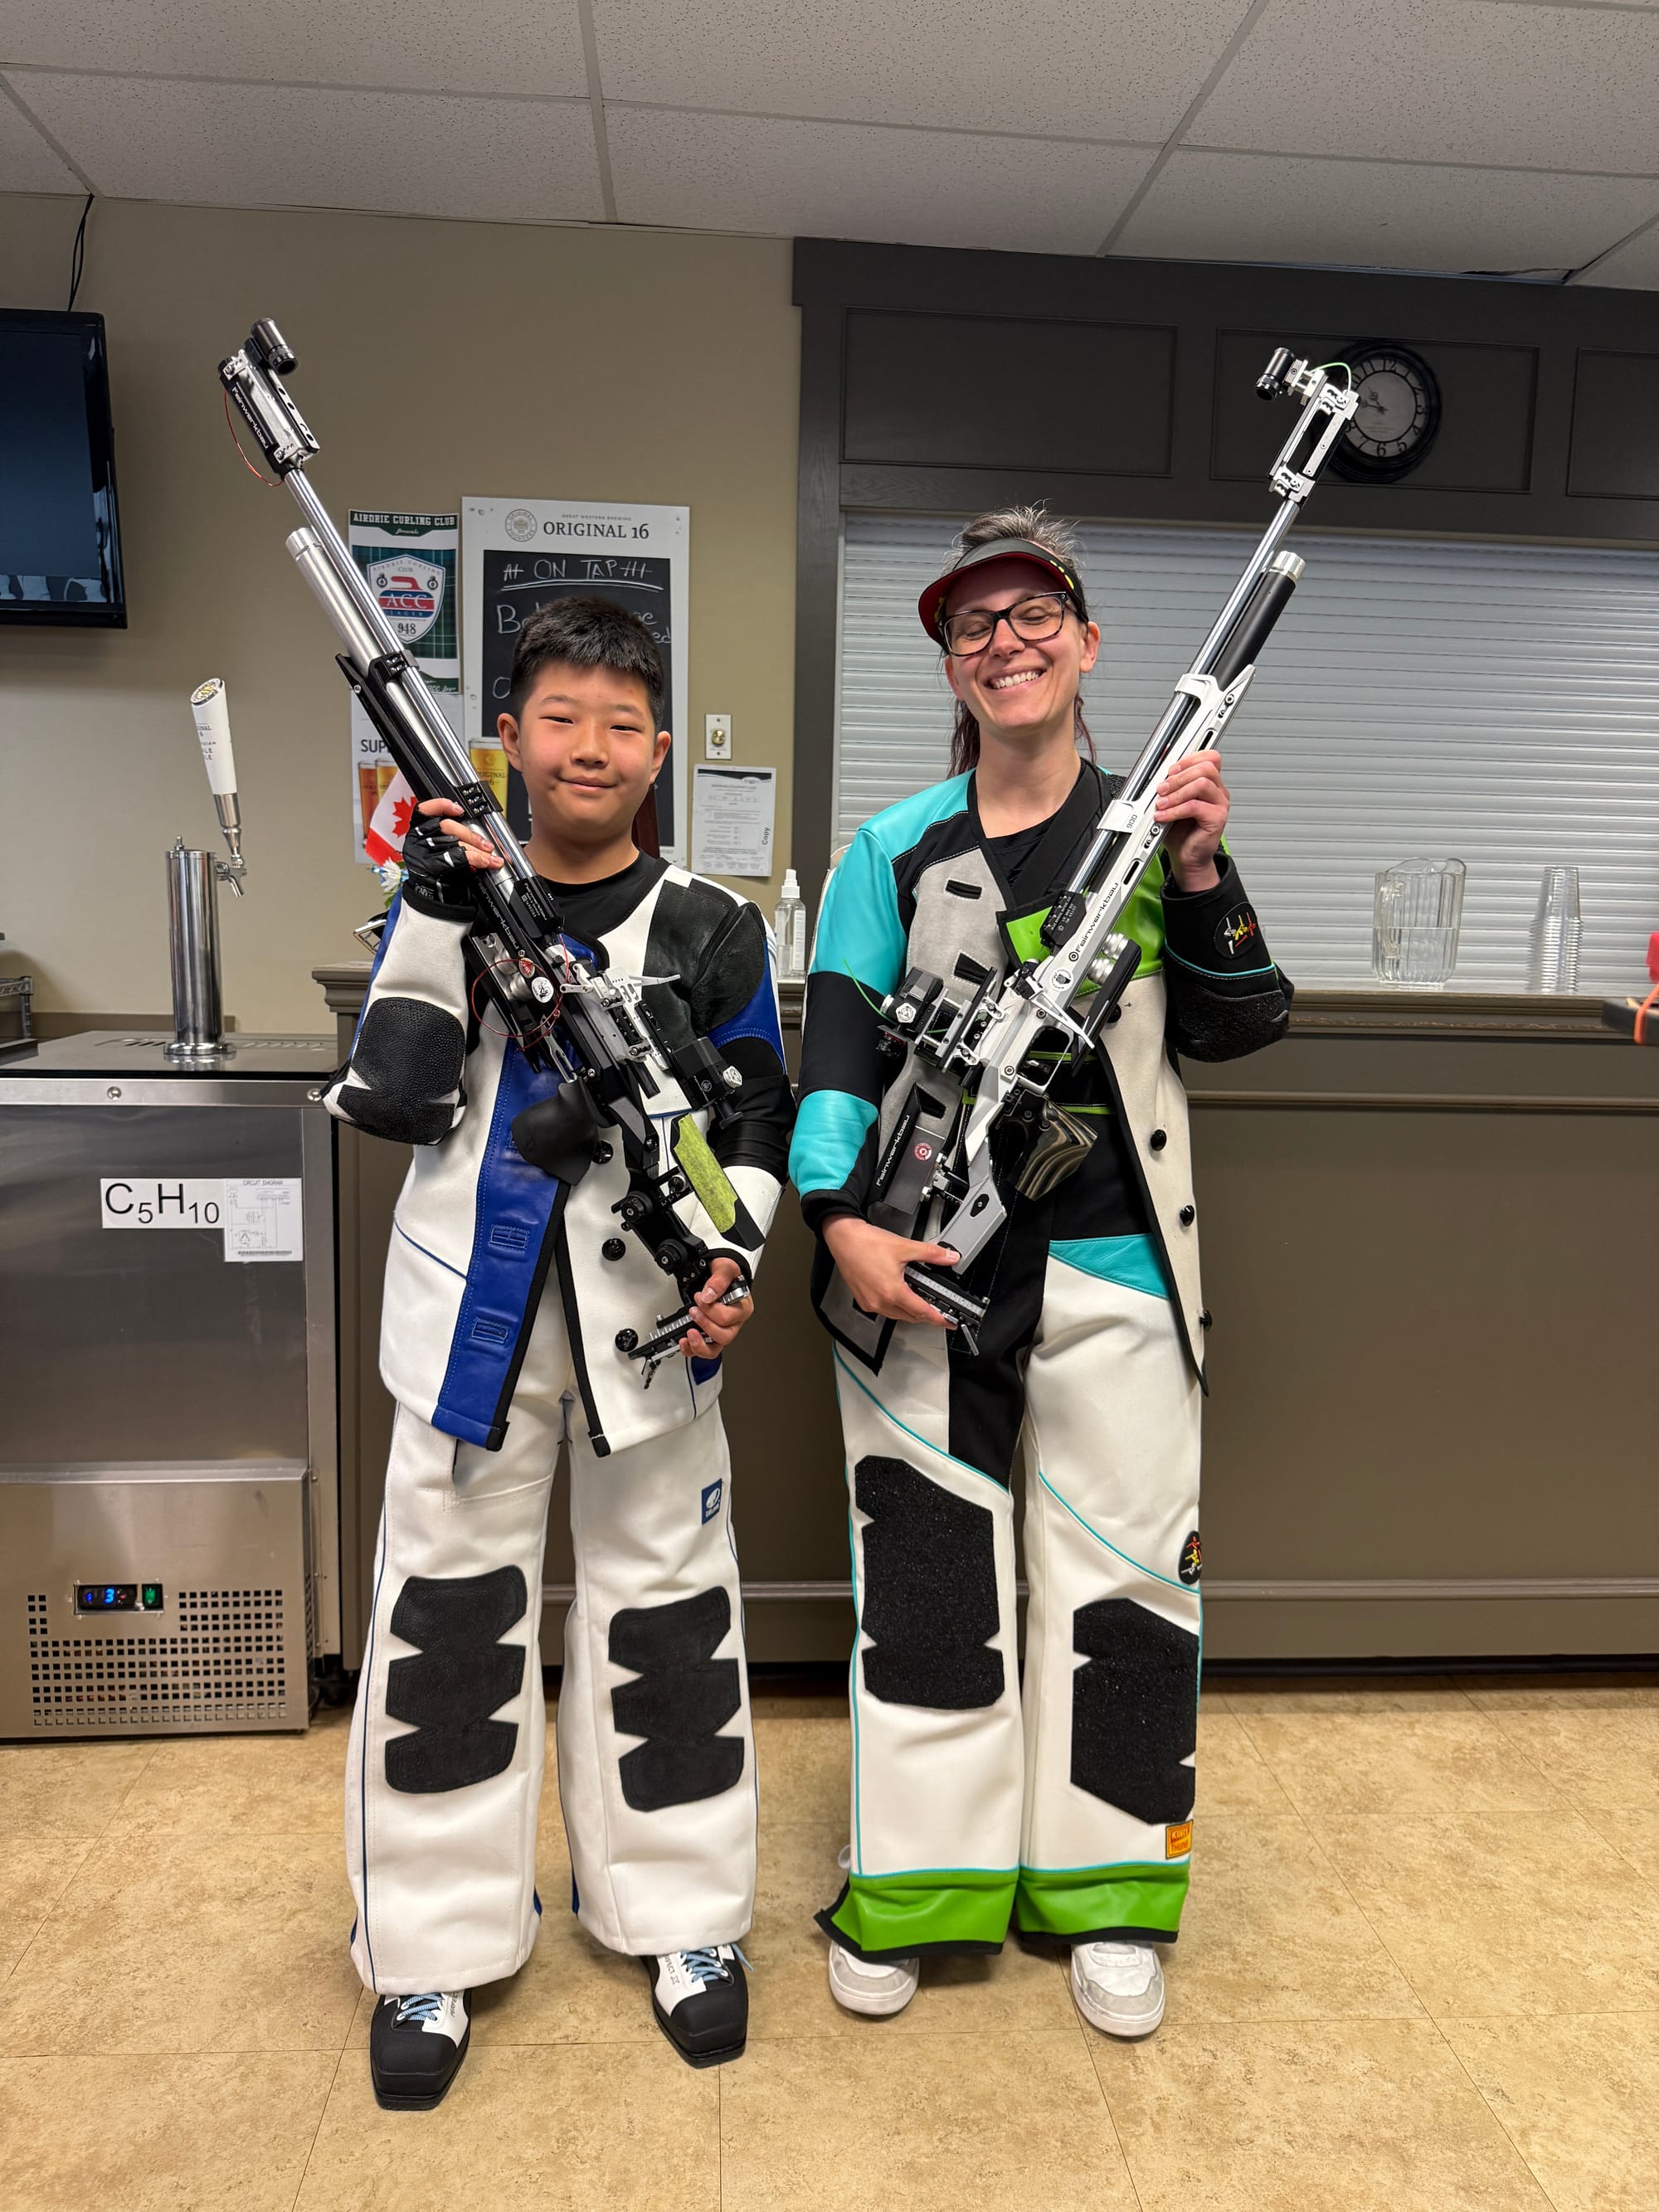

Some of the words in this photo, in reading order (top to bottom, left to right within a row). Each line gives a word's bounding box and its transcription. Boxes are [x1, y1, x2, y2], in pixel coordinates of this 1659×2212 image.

[353, 513, 389, 523] AIRDRIE
[392, 515, 431, 526] CURLING
[435, 518, 455, 526] CLUB
[543, 522, 627, 538] ORIGINAL
[631, 523, 649, 539] 16
[534, 559, 566, 580] ON
[581, 559, 617, 581] TAP
[387, 593, 427, 609] ACC
[398, 622, 416, 634] 948
[361, 739, 390, 753] SUP
[1126, 814, 1138, 829] 900
[761, 827, 771, 846] Copy
[1076, 882, 1119, 953] Feinwerkbau
[876, 1115, 910, 1186] Feinwerkbau
